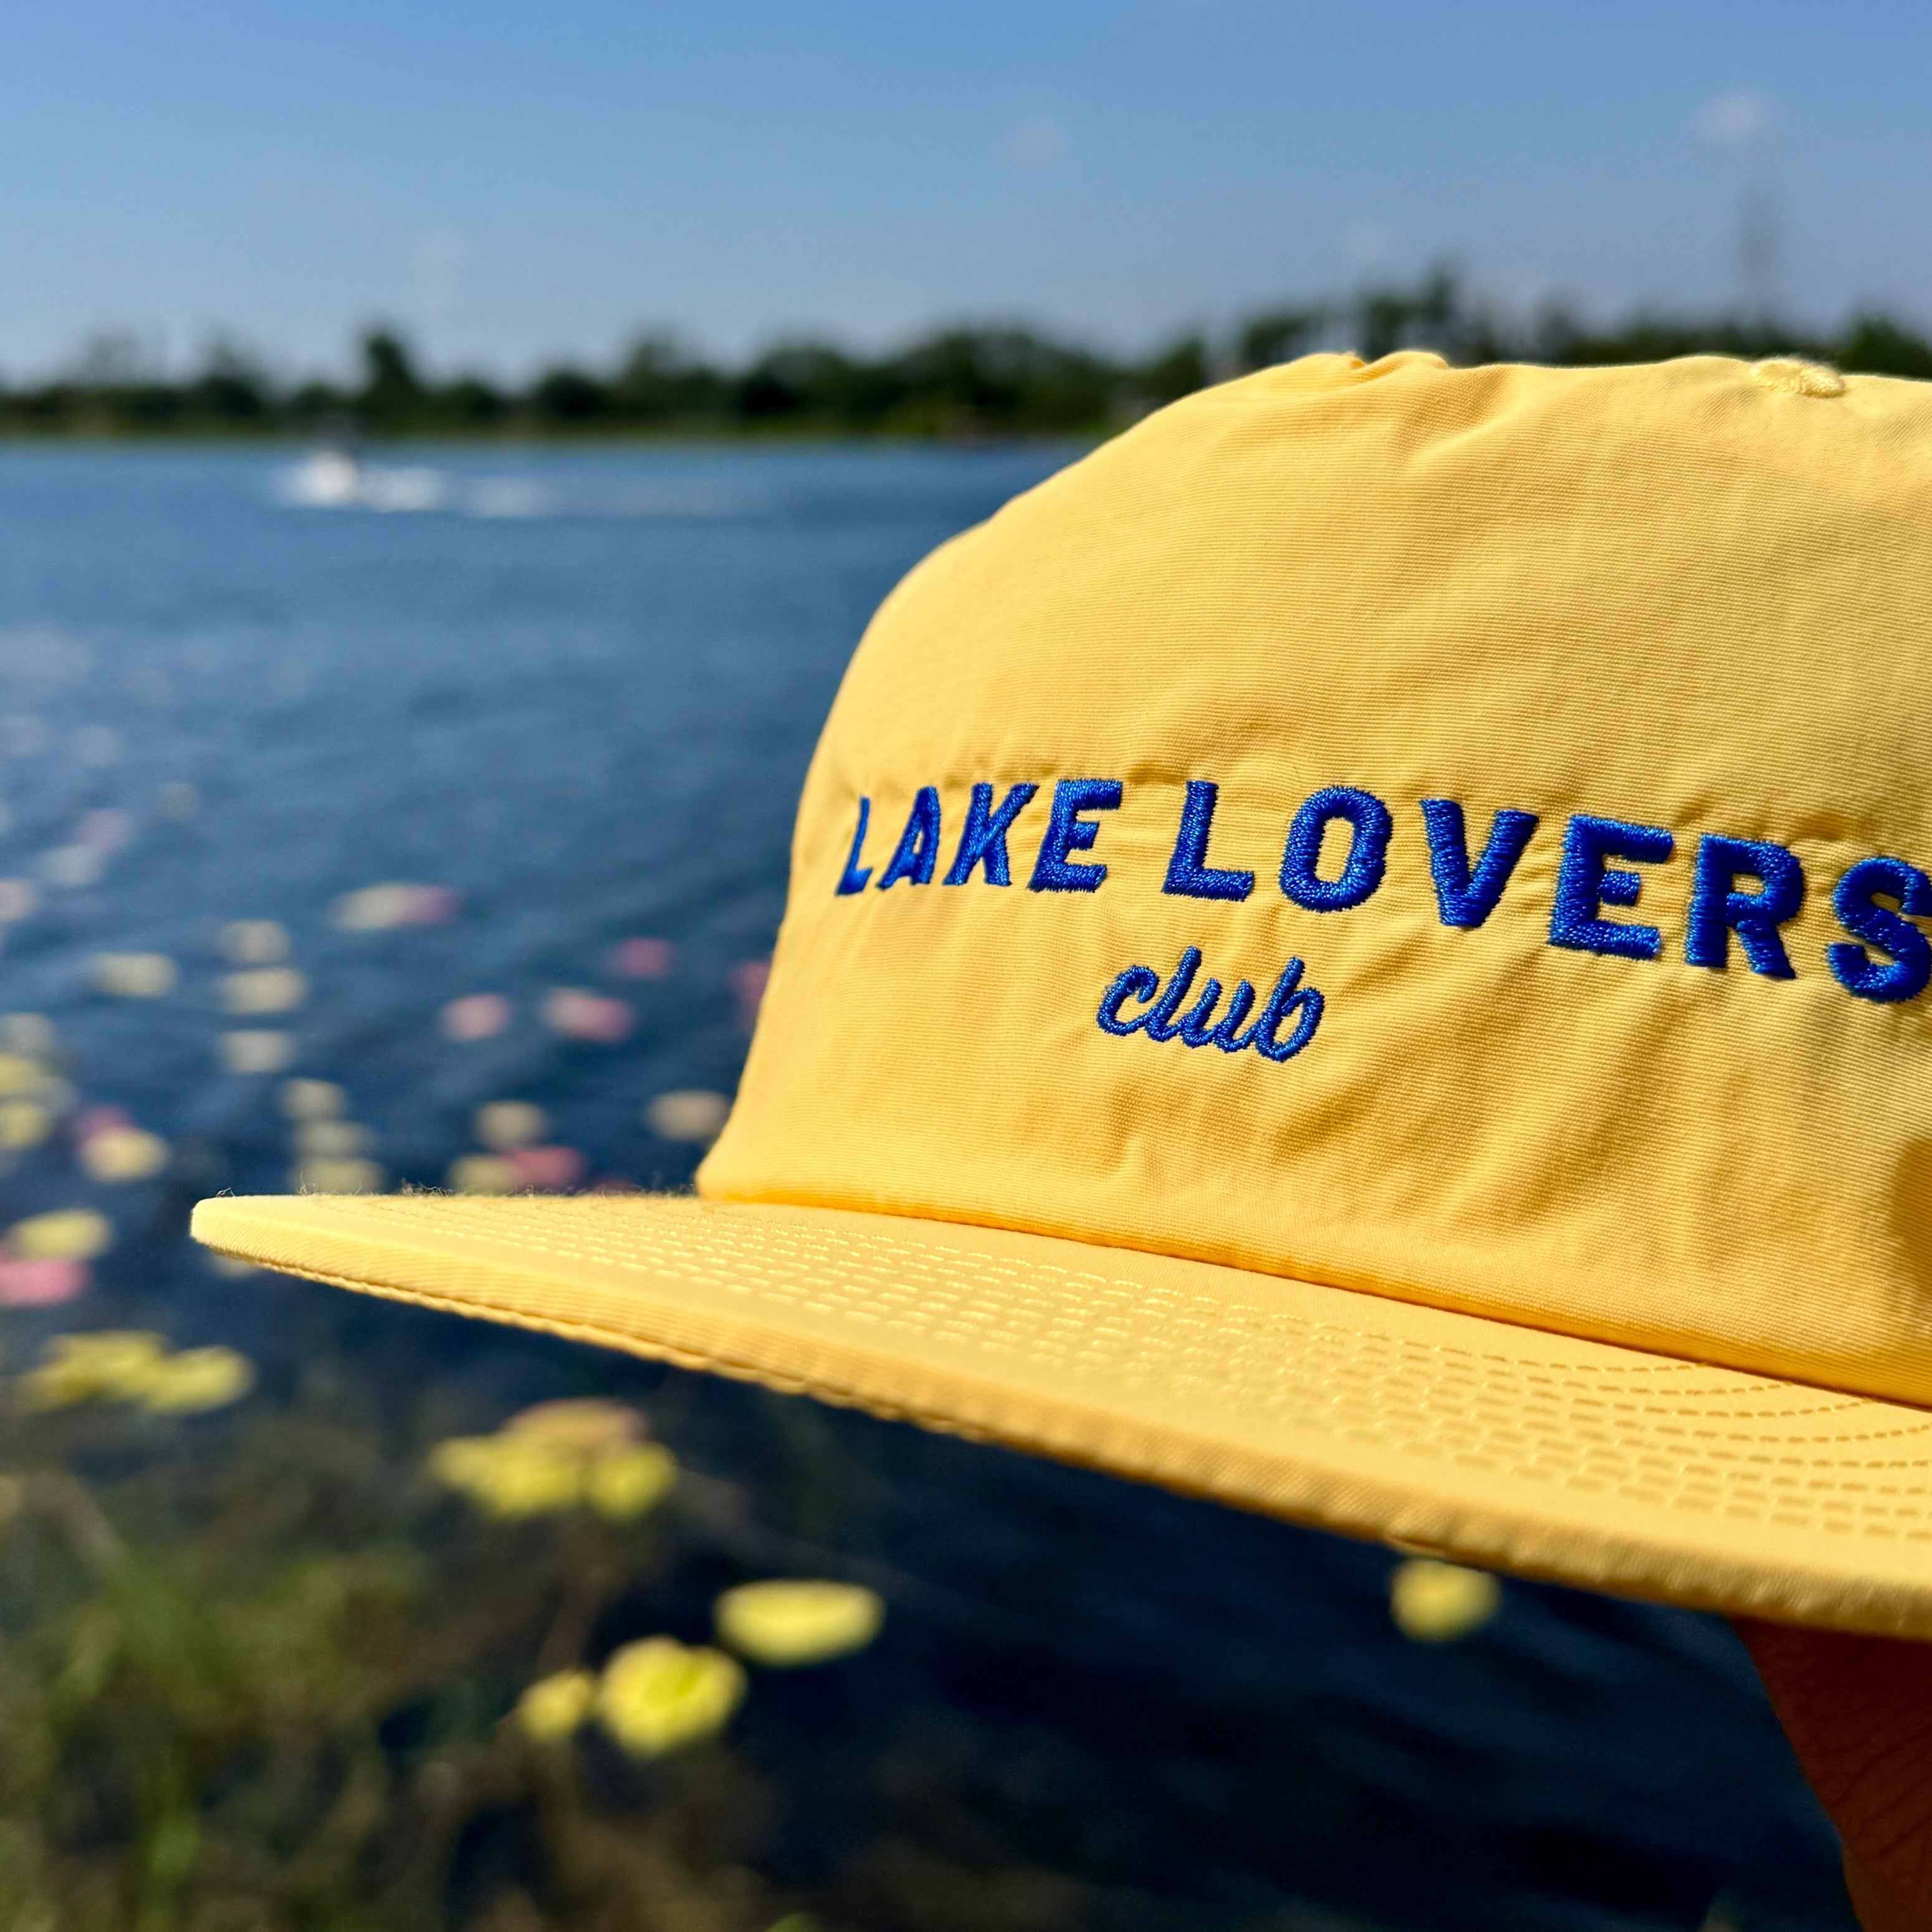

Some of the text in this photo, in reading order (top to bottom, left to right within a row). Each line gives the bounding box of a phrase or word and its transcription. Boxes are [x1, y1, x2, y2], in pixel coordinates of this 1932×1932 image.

[836, 779, 1932, 1002] LAKE LOVERS
[1096, 945, 1324, 1063] club
